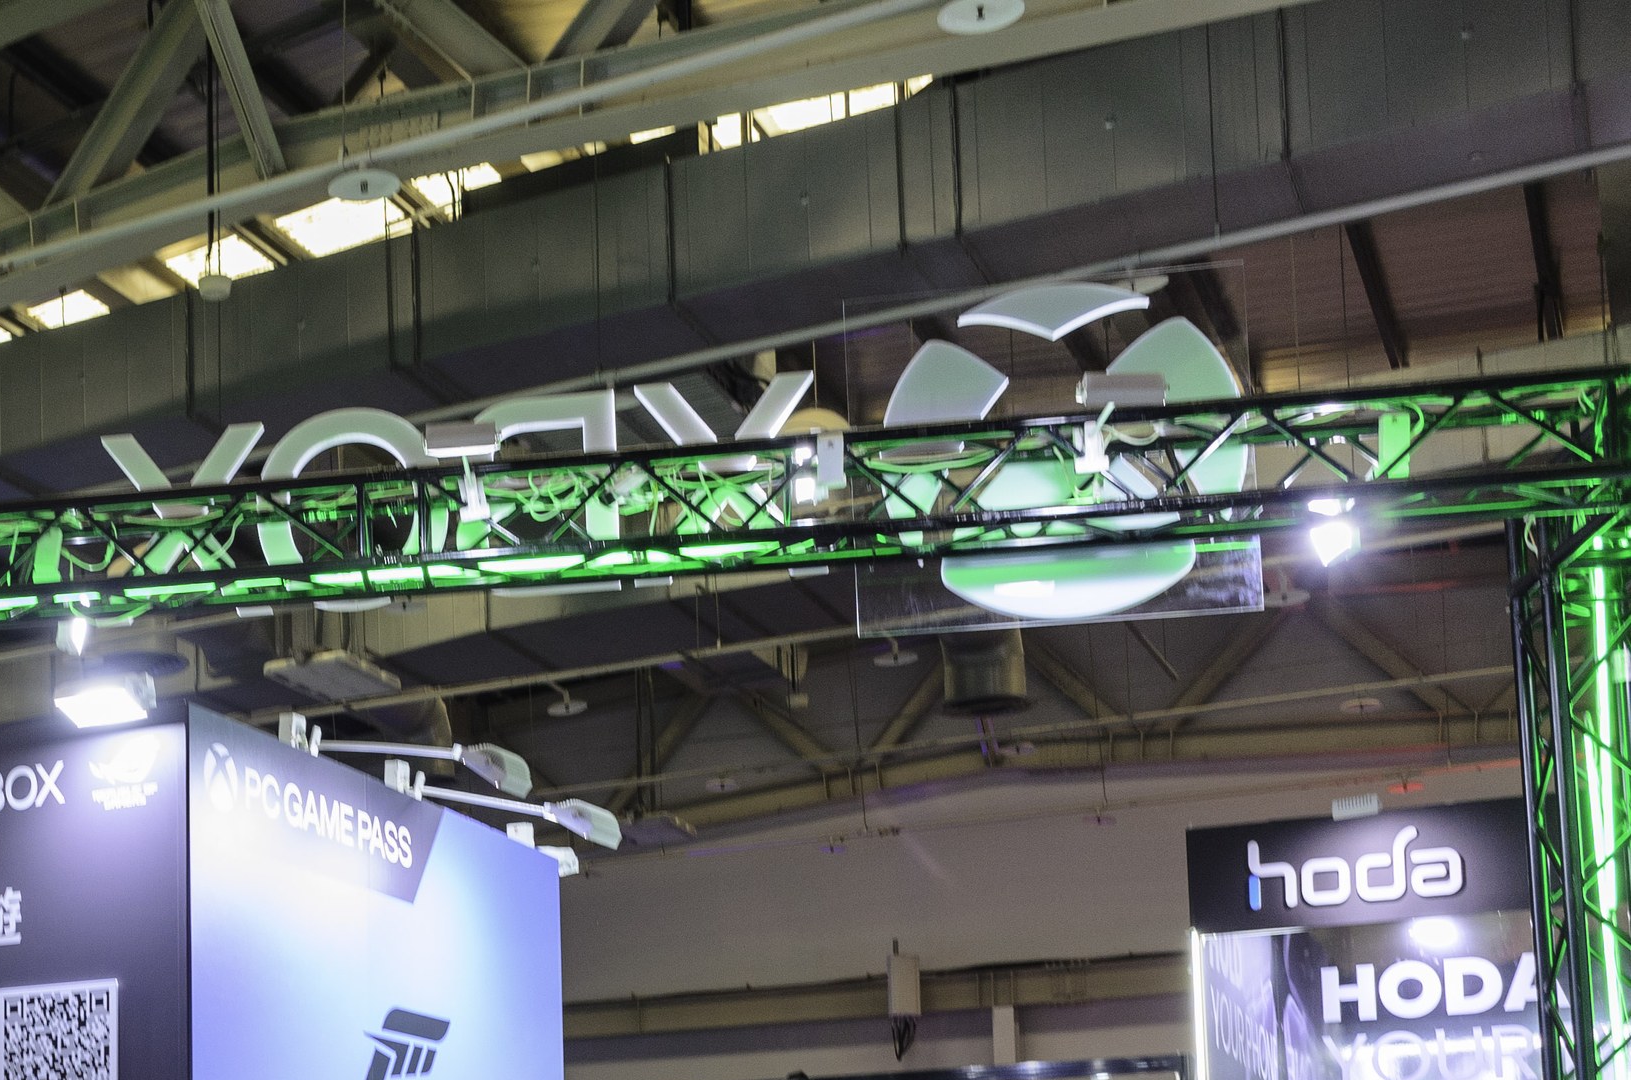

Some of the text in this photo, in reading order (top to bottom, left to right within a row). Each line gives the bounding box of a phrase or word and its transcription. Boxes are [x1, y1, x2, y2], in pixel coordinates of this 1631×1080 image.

[243, 766, 413, 870] PC GAME PASS
[1246, 824, 1464, 910] hoda
